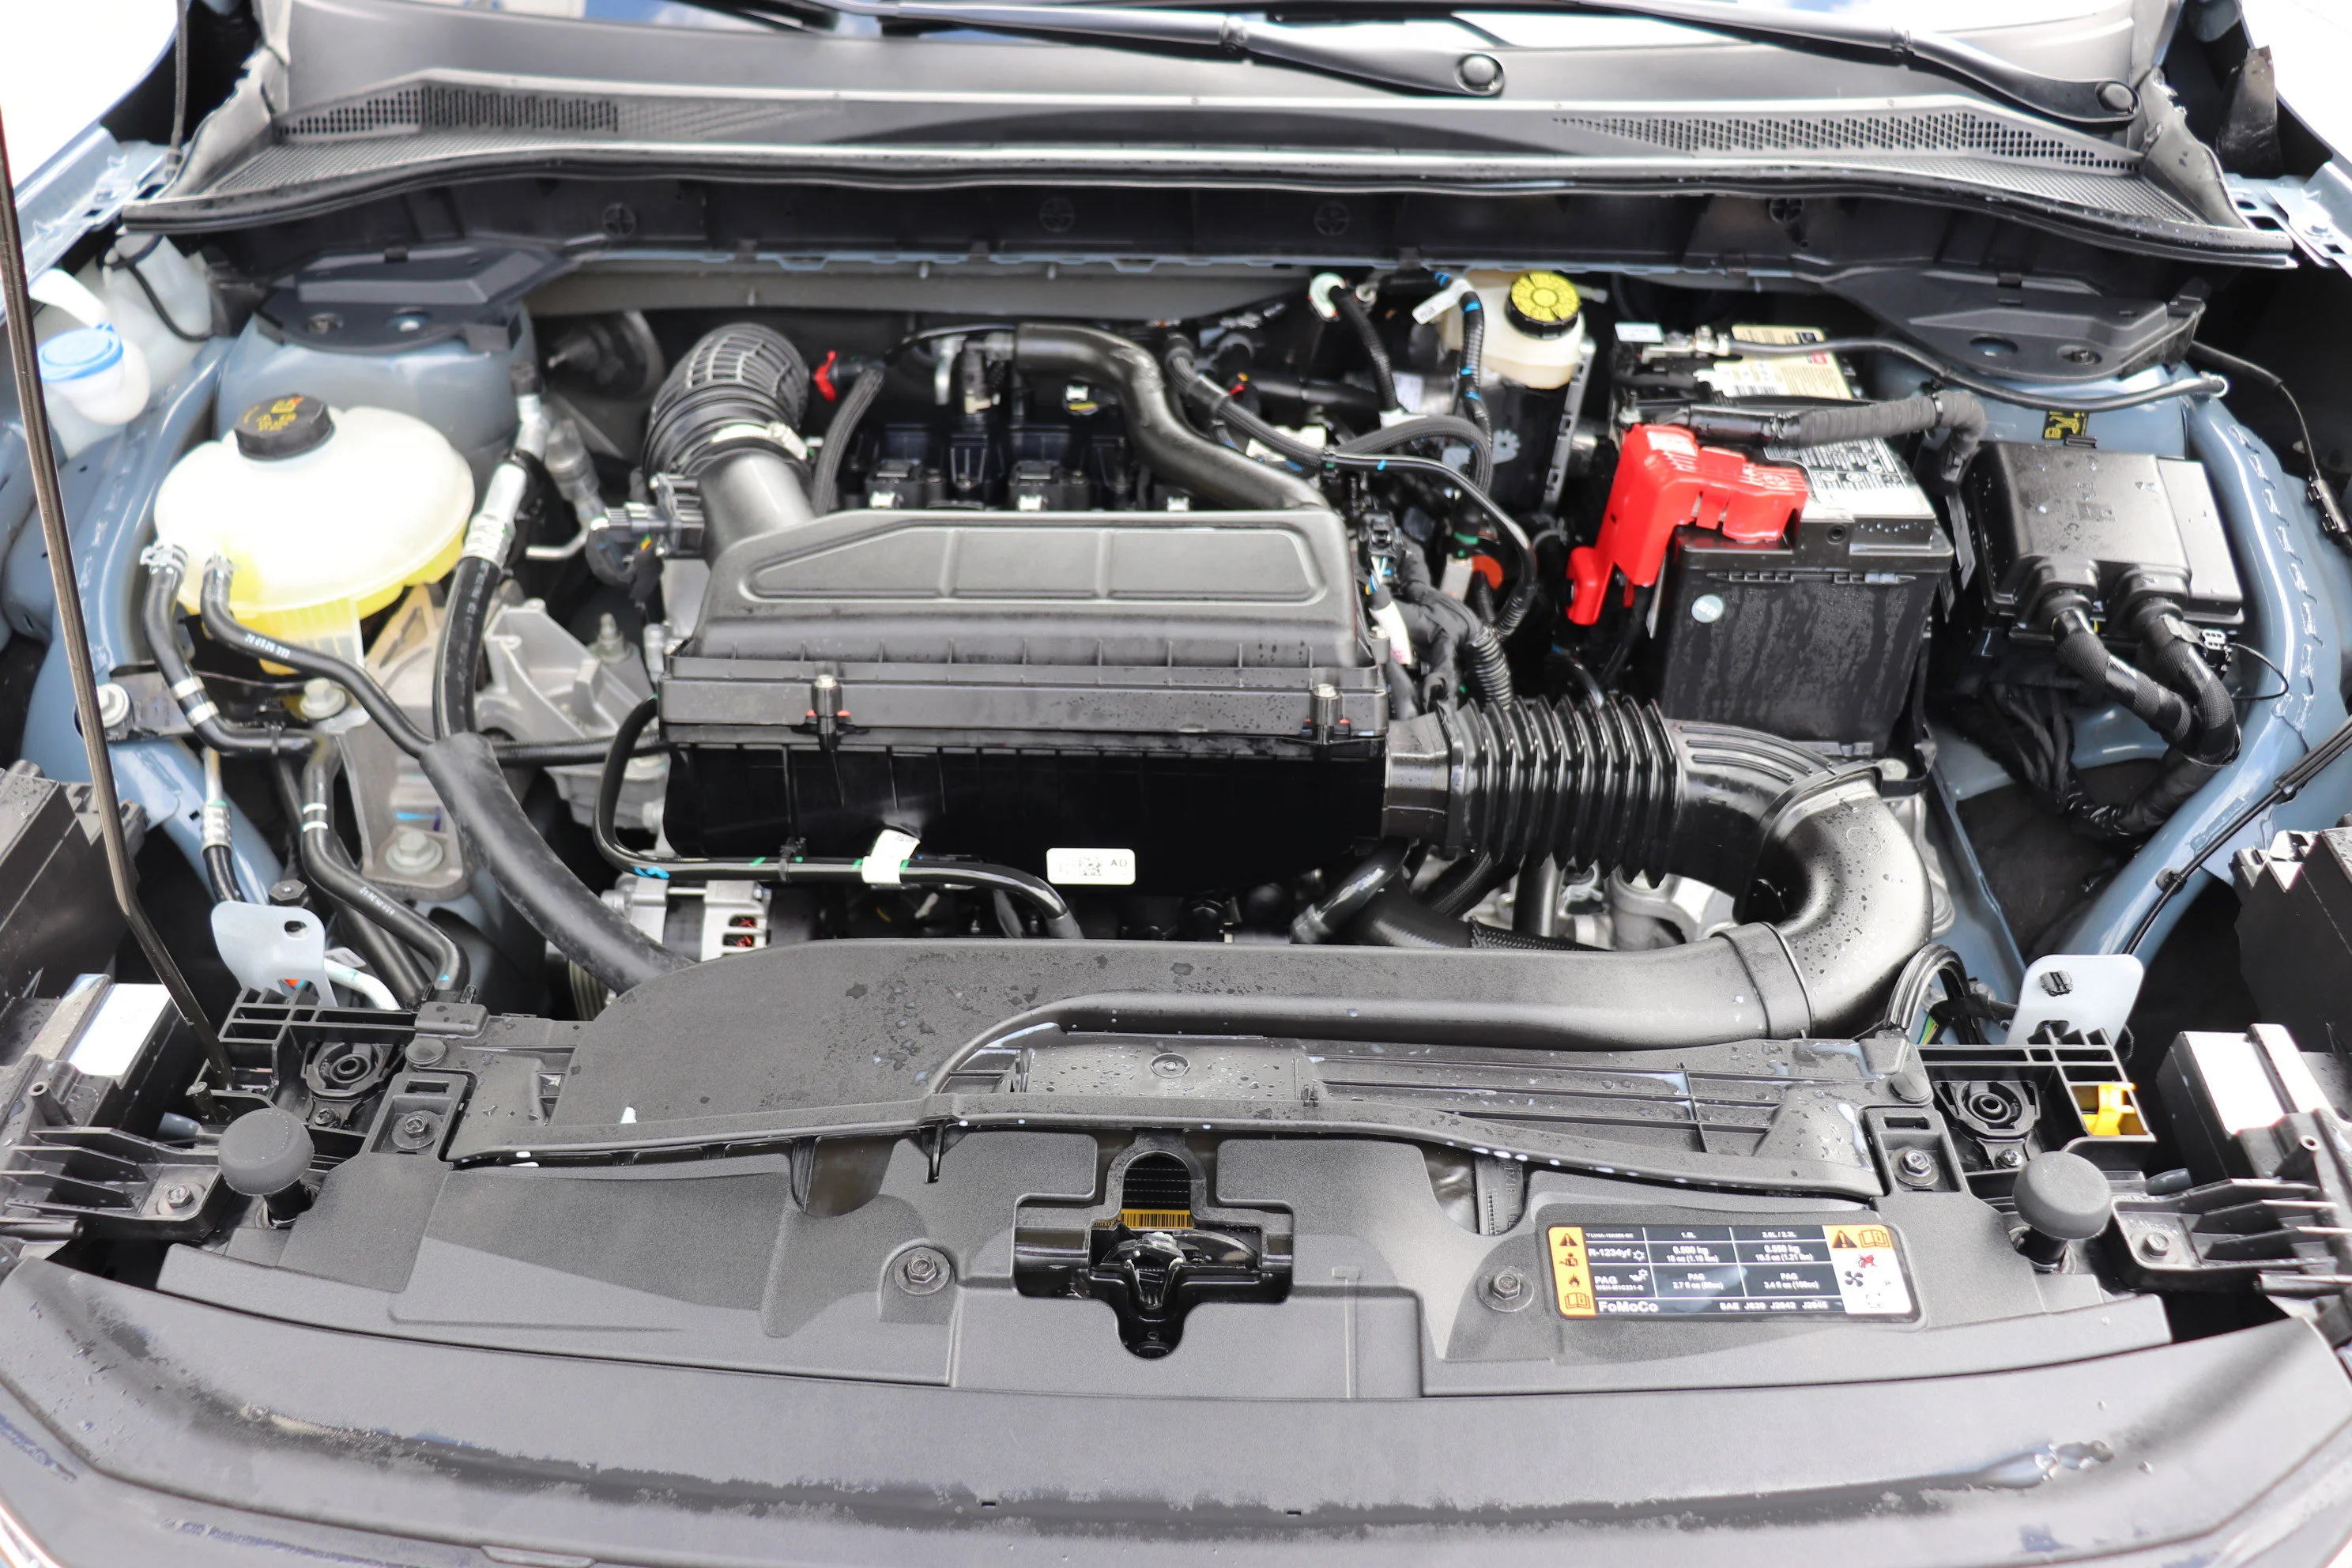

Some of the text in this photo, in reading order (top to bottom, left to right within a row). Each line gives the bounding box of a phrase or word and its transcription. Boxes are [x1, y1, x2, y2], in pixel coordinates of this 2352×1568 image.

[1588, 1248, 1631, 1259] R-1234yf
[1697, 1246, 1709, 1256] kg
[1788, 1245, 1800, 1254] kg
[1593, 1276, 1619, 1285] PAG
[1687, 1272, 1706, 1281] PAG
[1598, 1301, 1659, 1313] FoMoCo
